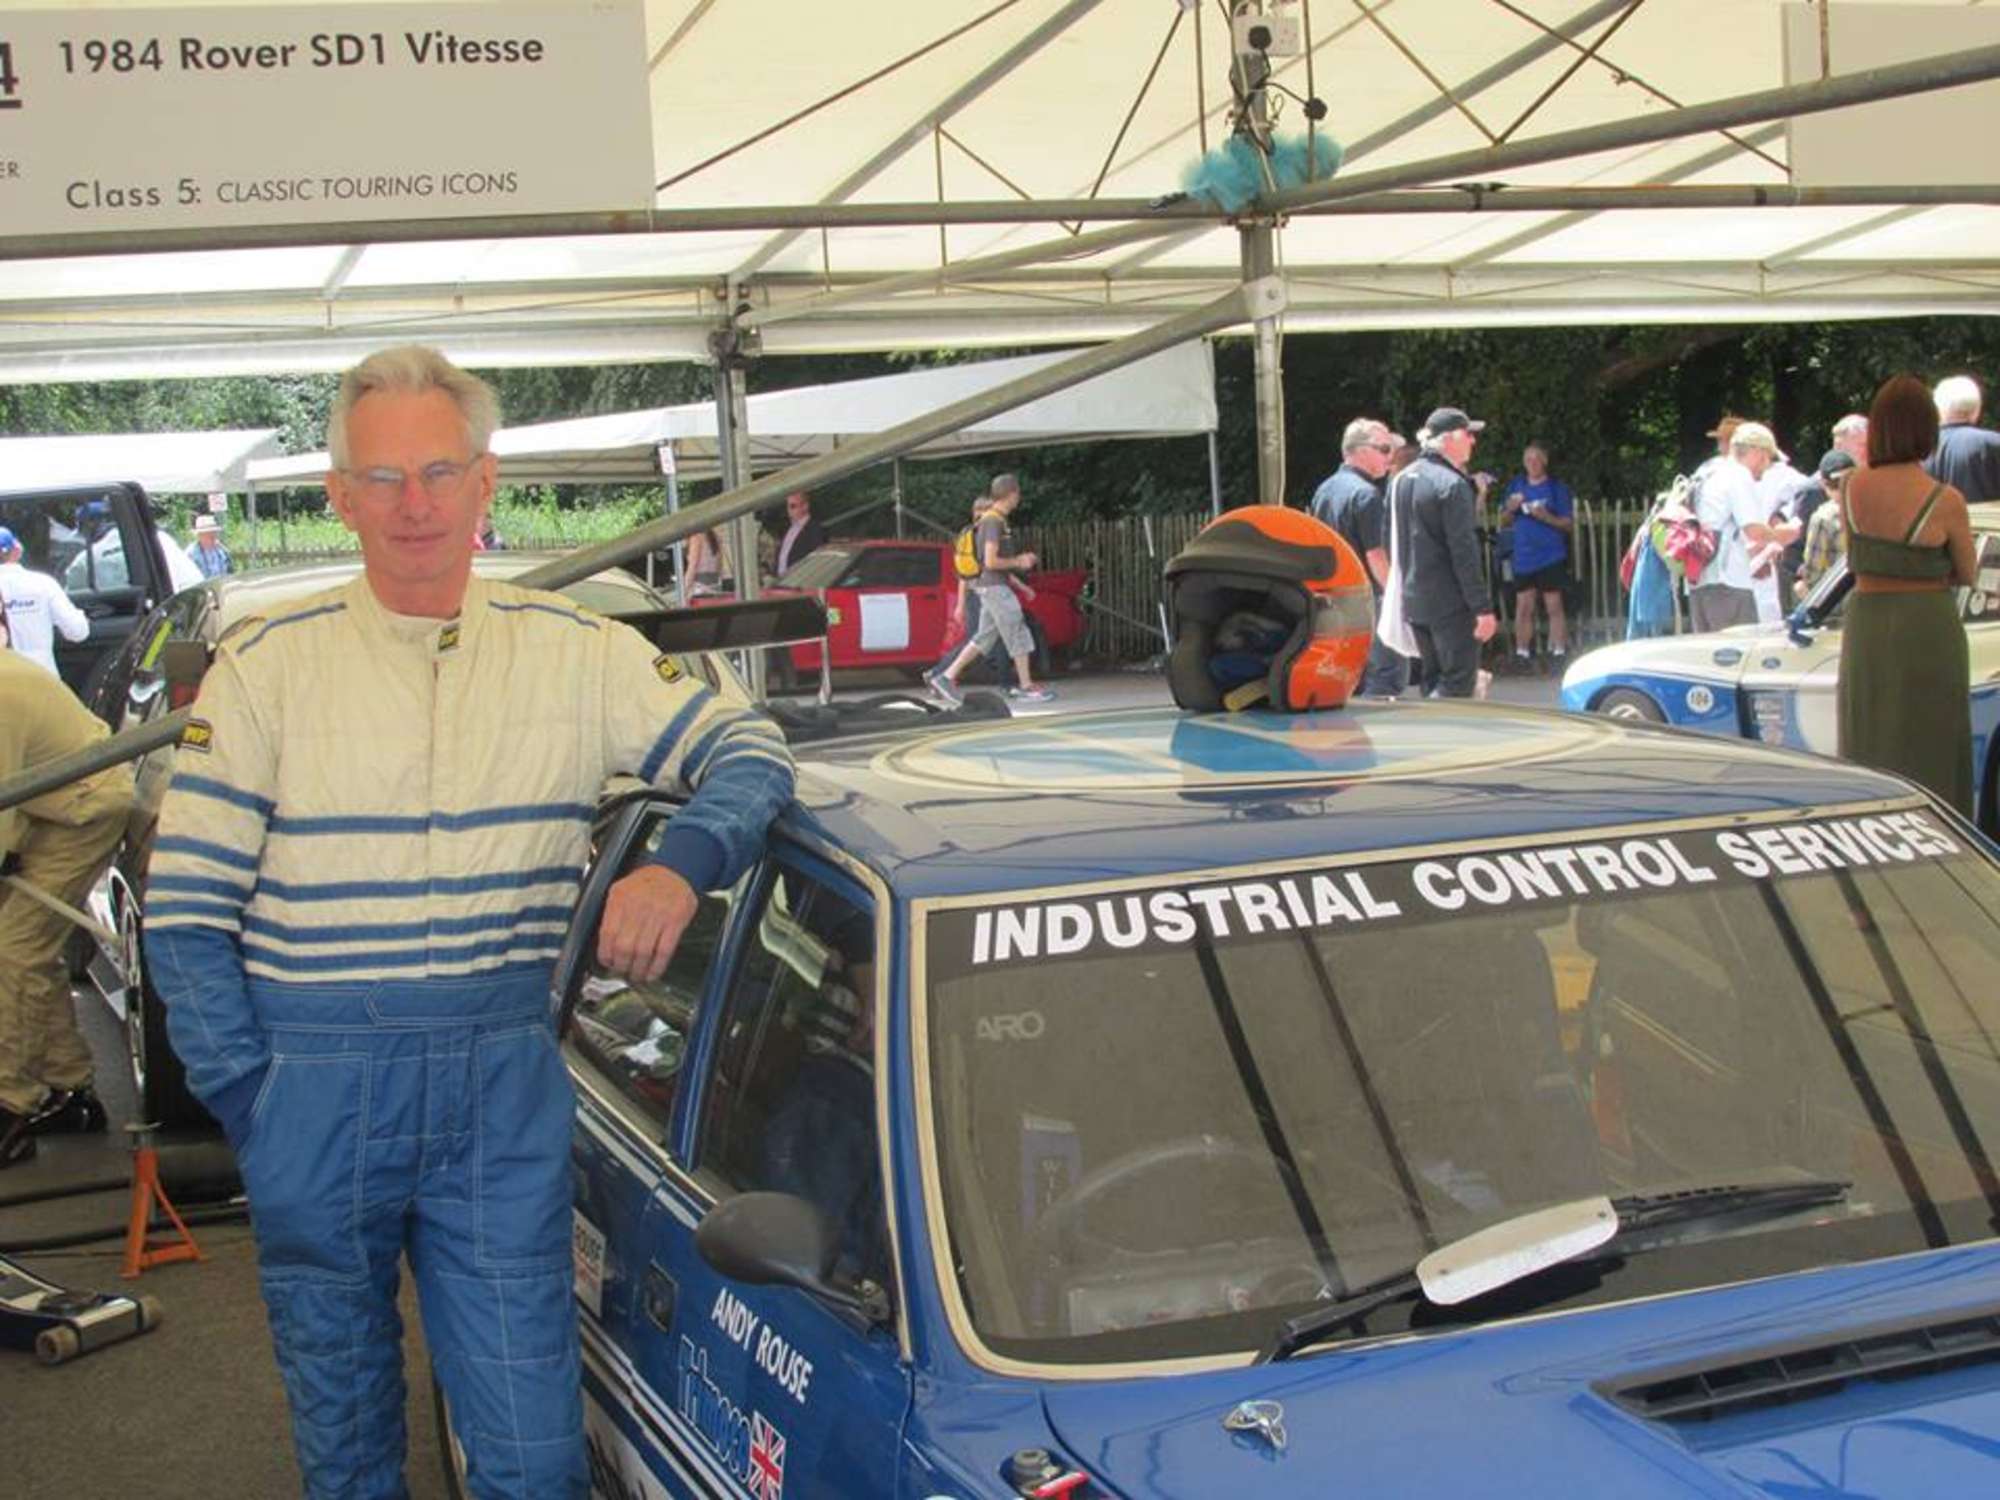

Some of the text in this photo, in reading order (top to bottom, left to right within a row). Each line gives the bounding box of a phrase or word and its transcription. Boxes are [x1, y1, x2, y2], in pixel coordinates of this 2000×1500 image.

[59, 30, 544, 73] 1984 Rover SD1 Vitesse
[65, 171, 518, 210] Class 5: CLASSIC TOURING ICONS
[972, 811, 1962, 964] INDUSTRIAL CONTROL SERVICES
[711, 1286, 814, 1405] ANDY ROUSE
